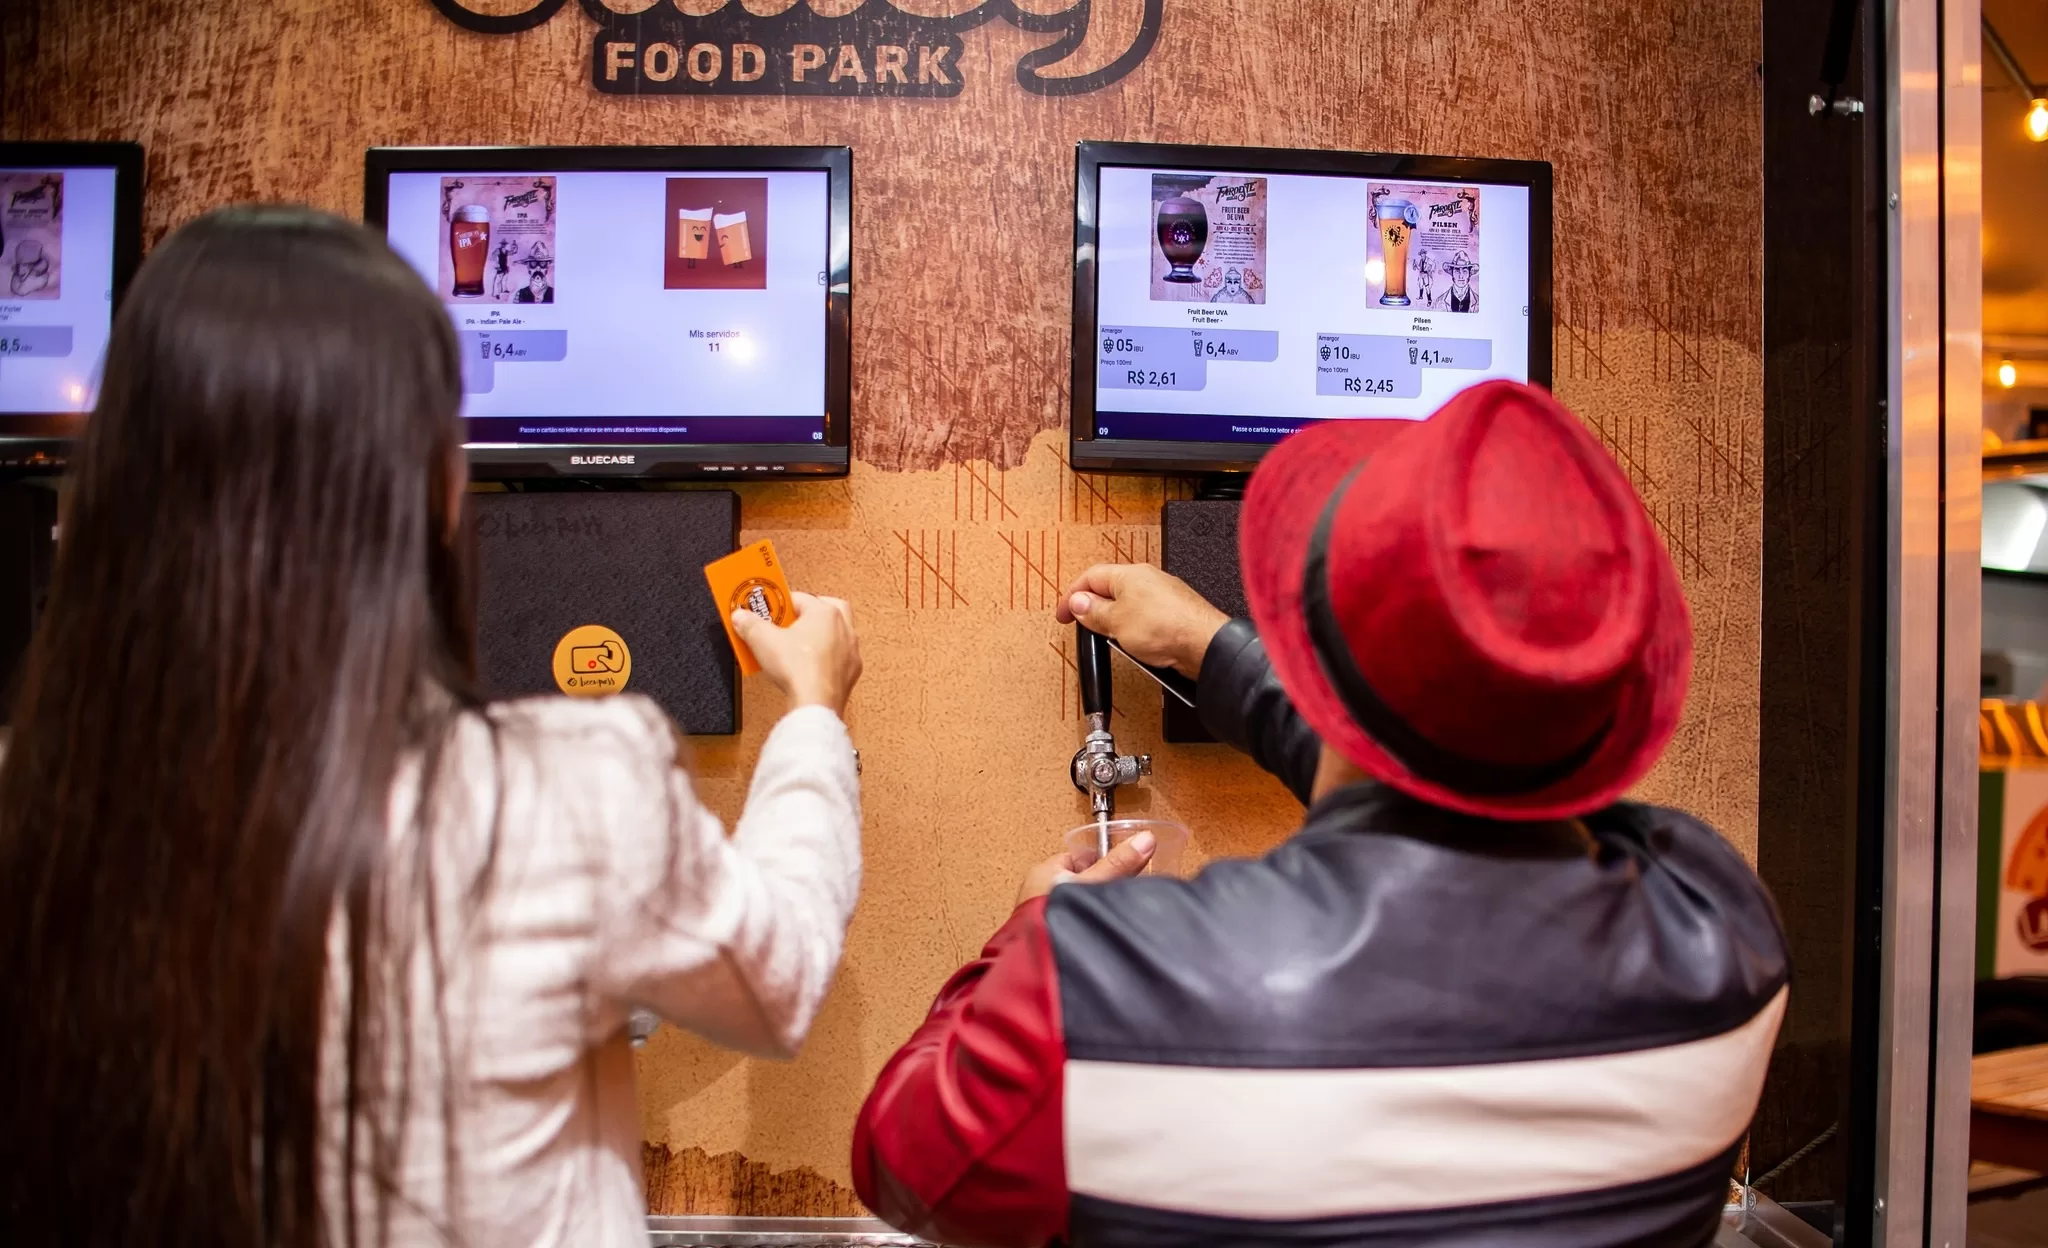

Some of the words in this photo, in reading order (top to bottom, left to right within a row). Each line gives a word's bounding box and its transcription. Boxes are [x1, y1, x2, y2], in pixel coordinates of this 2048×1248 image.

[604, 41, 767, 83] FOOD
[792, 43, 952, 85] PARK
[1221, 206, 1237, 214] FRUIT
[459, 237, 472, 248] IPA
[1201, 308, 1215, 316] Beer
[706, 330, 740, 338] servidos
[0, 338, 20, 356] 8,5
[494, 343, 514, 359] 6,4
[708, 343, 720, 352] 11
[1116, 338, 1133, 352] 05
[1206, 341, 1226, 357] 6,4
[1333, 346, 1350, 360] 10
[1420, 349, 1440, 365] 4,1
[1440, 356, 1453, 364] ABV
[1317, 366, 1333, 374] Preço
[1127, 369, 1145, 386] R$
[1149, 371, 1176, 387] 2,61
[1344, 377, 1362, 393] R$
[1365, 379, 1394, 395] 2,45
[812, 432, 823, 440] 08
[1099, 427, 1109, 436] 09
[570, 456, 635, 465] BLUECASE
